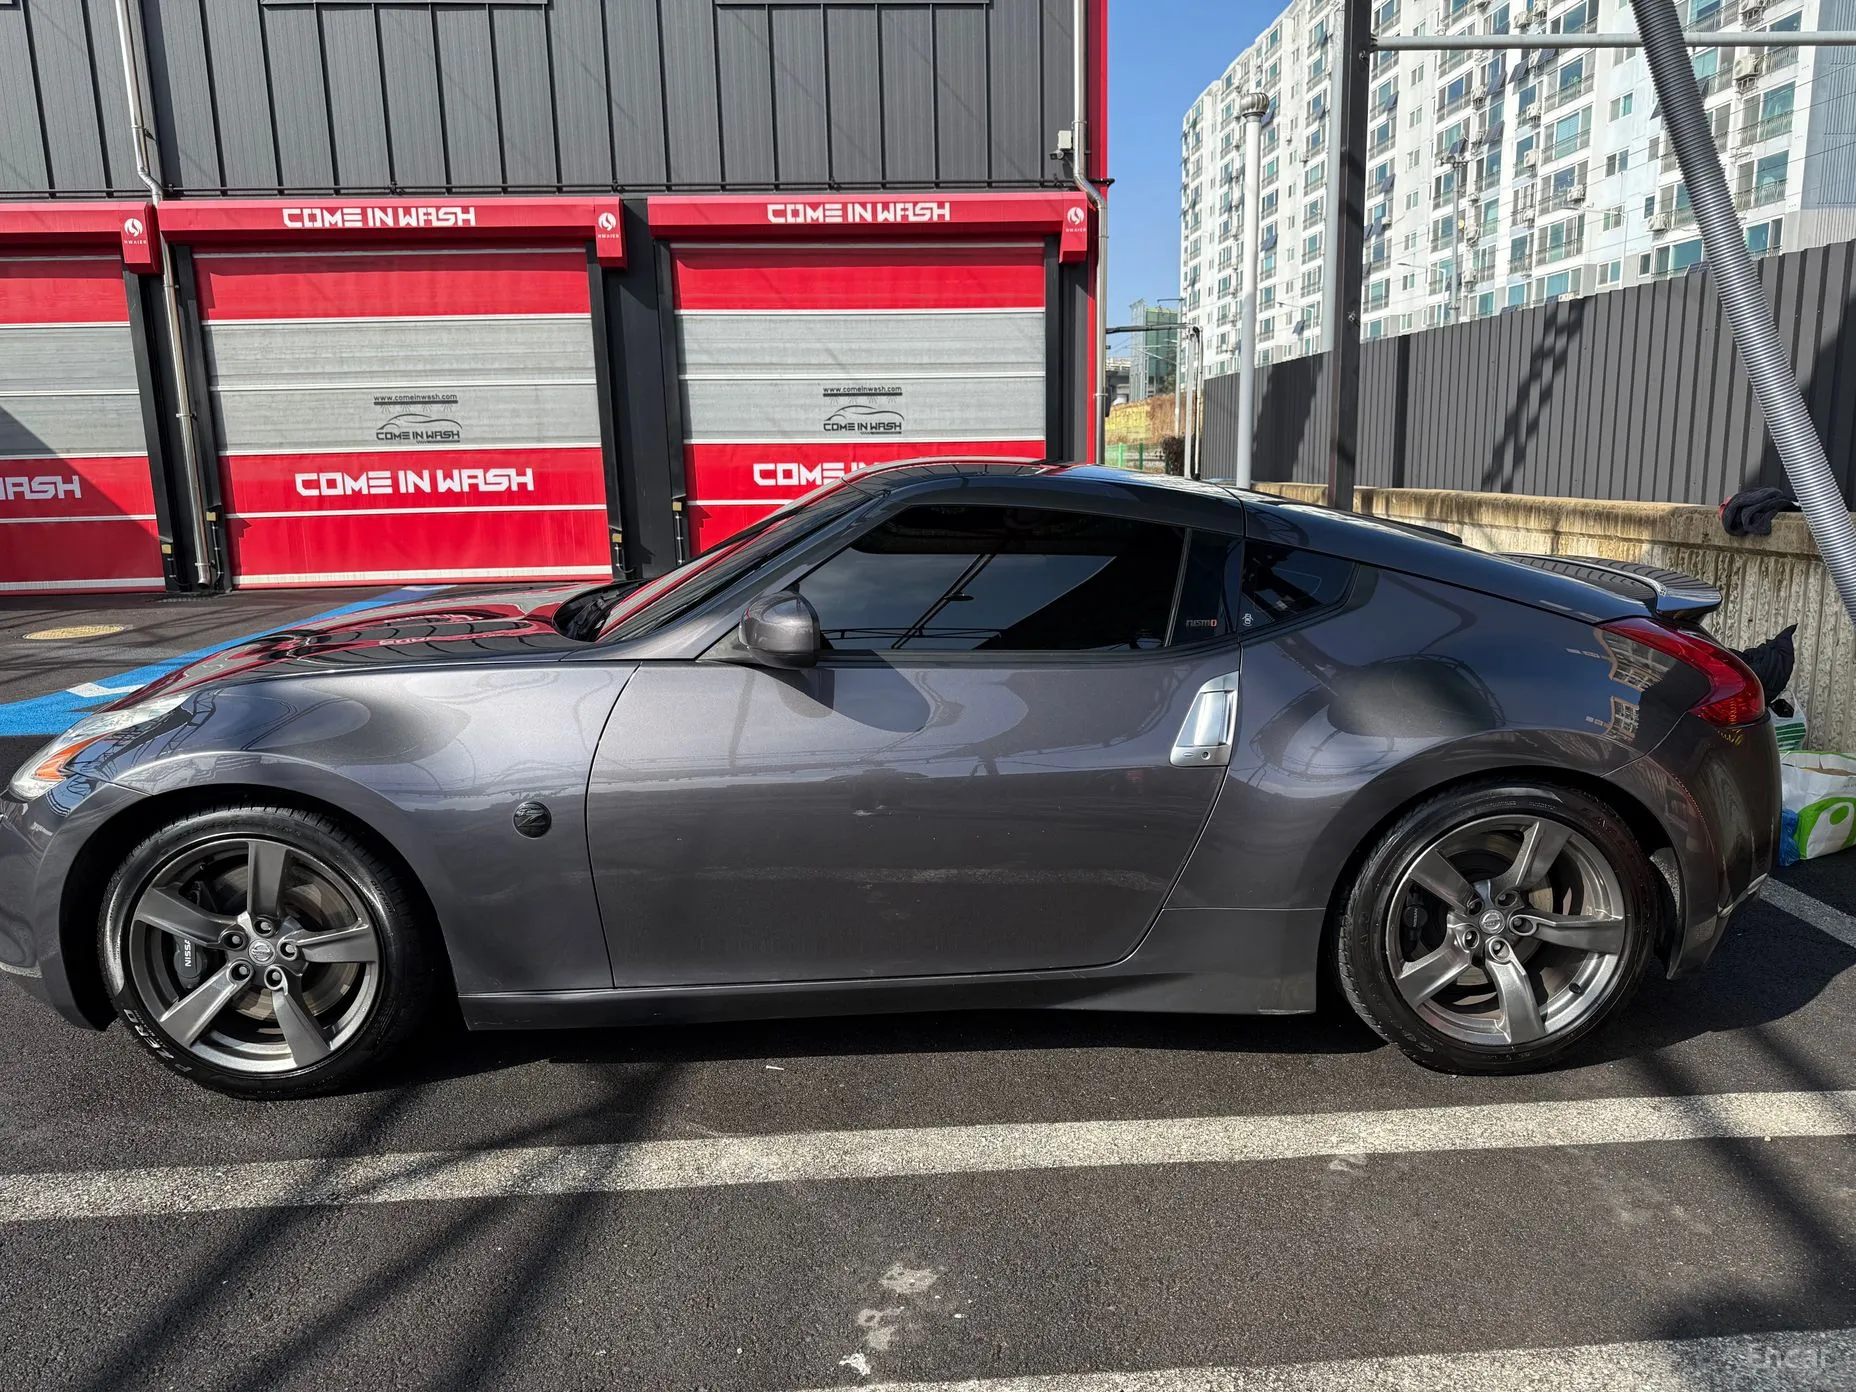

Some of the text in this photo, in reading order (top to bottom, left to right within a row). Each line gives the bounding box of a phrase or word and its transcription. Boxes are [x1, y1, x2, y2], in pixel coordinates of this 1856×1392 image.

[282, 206, 476, 228] COME IN WASH
[767, 202, 950, 223] COME IN WASH
[373, 393, 458, 401] www.comeinwash.com
[823, 385, 902, 393] www.comeinwash.com
[823, 422, 902, 432] COME IN WASH
[375, 430, 460, 441] COME IN WASH
[295, 468, 535, 496] COME IN WASH
[753, 462, 845, 486] COME
